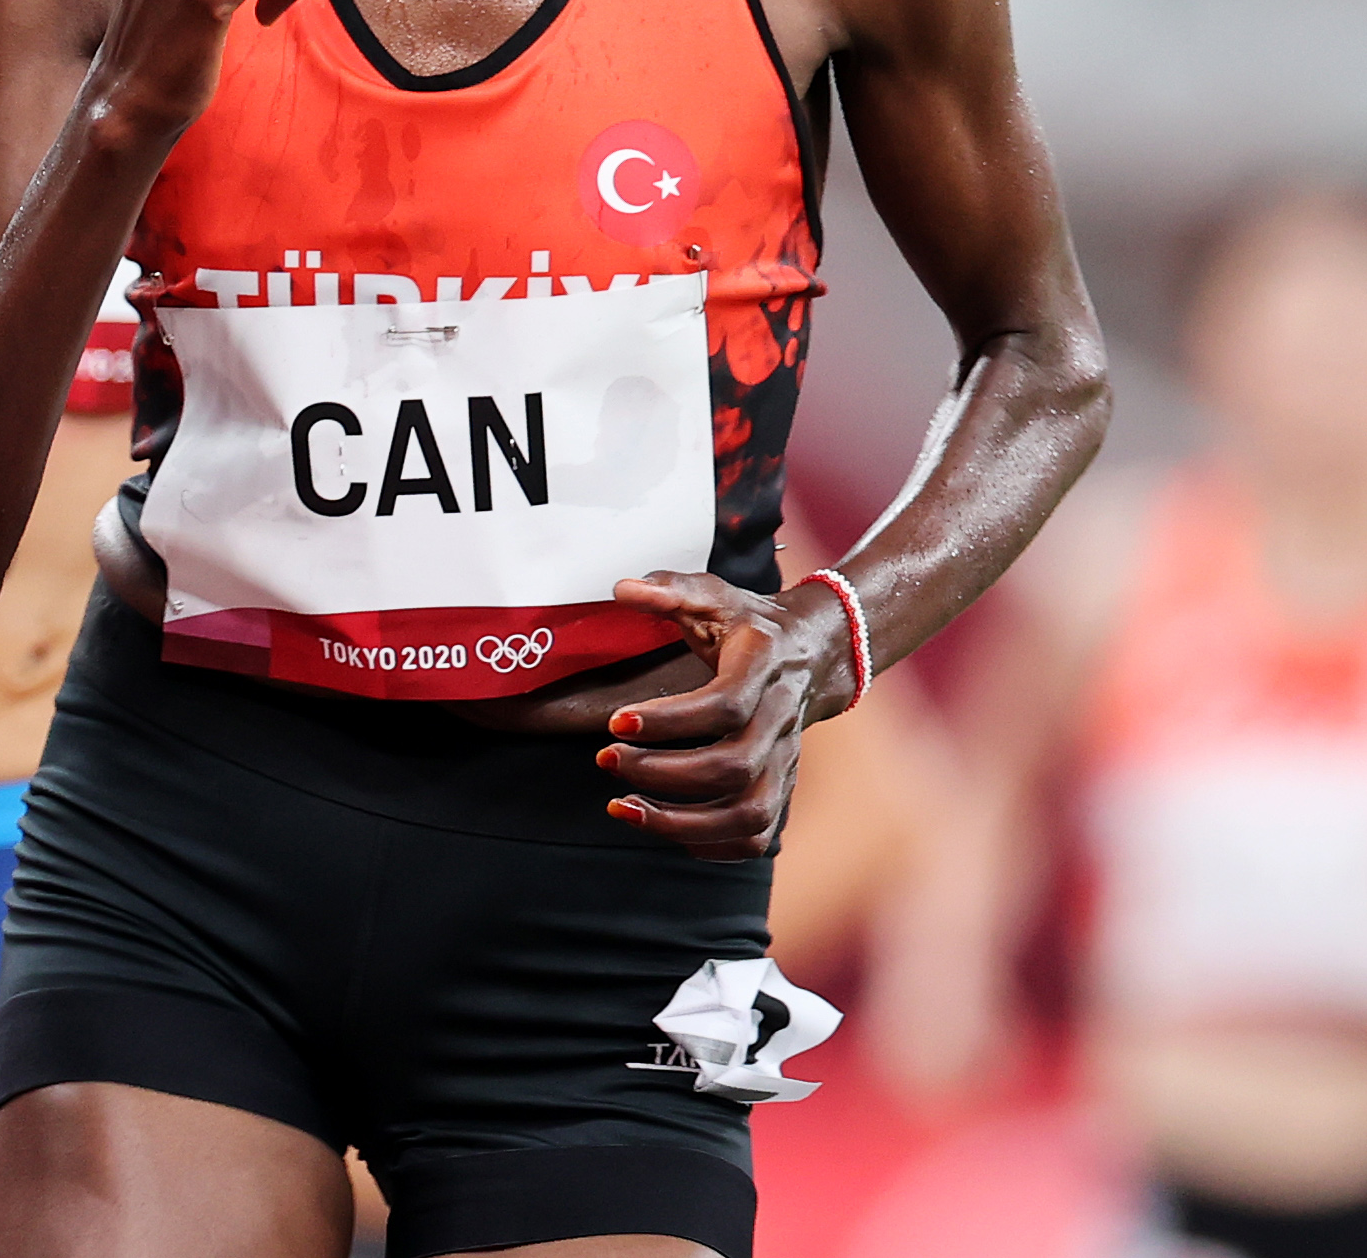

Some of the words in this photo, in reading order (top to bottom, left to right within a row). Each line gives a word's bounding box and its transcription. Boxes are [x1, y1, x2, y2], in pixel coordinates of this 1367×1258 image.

[291, 392, 549, 518] CAN
[318, 637, 397, 671] TOKYO
[401, 644, 467, 670] 2020
